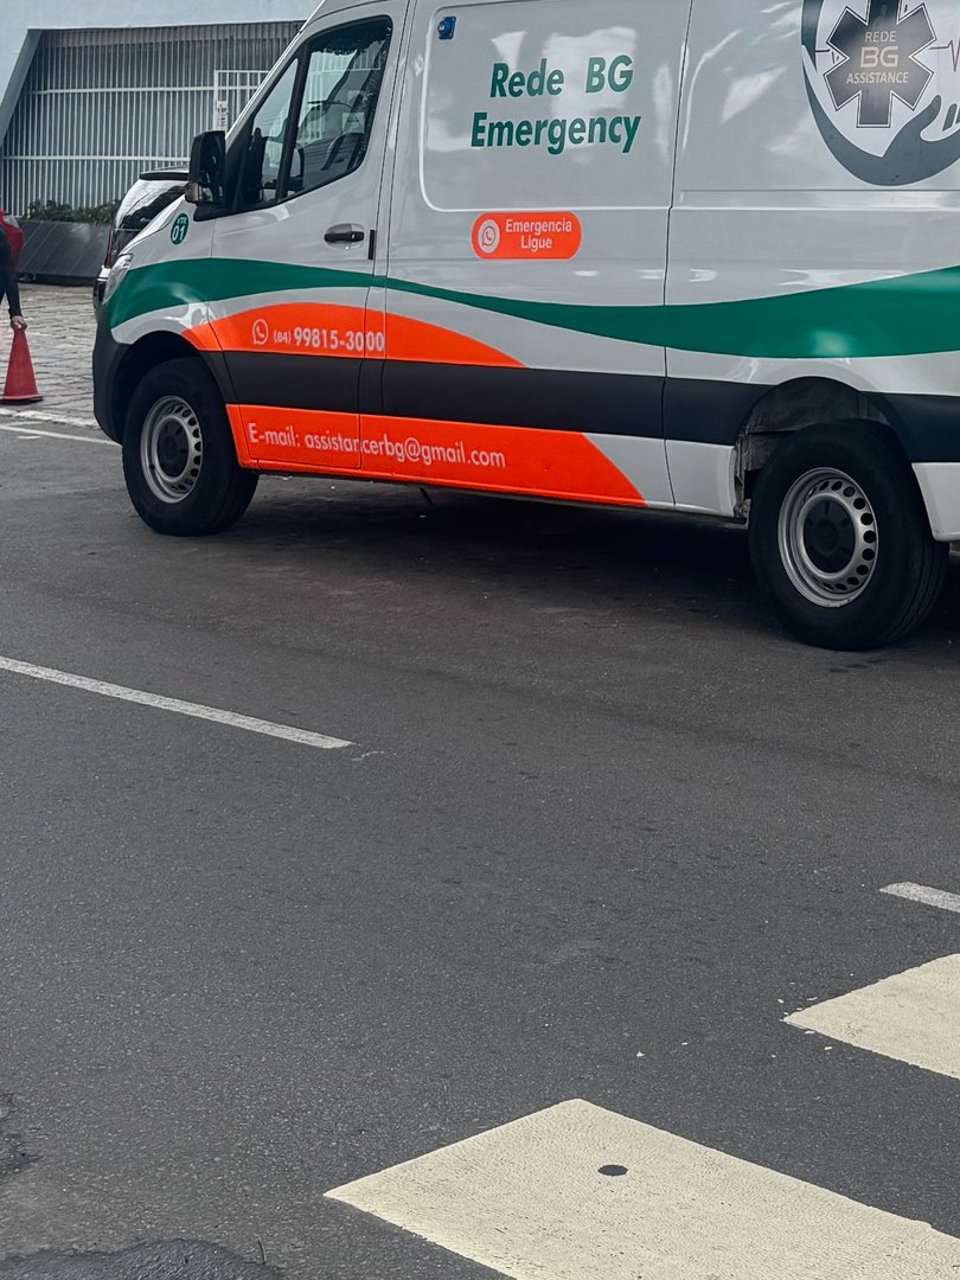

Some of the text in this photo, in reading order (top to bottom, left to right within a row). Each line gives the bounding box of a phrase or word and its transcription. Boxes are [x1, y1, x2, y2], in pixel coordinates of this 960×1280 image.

[864, 31, 896, 43] REDE
[860, 45, 899, 68] BG
[490, 55, 634, 98] Rede BG
[846, 71, 909, 84] ASSISTANCE
[470, 111, 641, 155] Emergency
[173, 225, 185, 241] 01
[505, 218, 573, 236] Emergencia
[520, 236, 553, 253] Ligue
[273, 326, 385, 352] (84) 99815-3000
[248, 422, 301, 447] E-mail:
